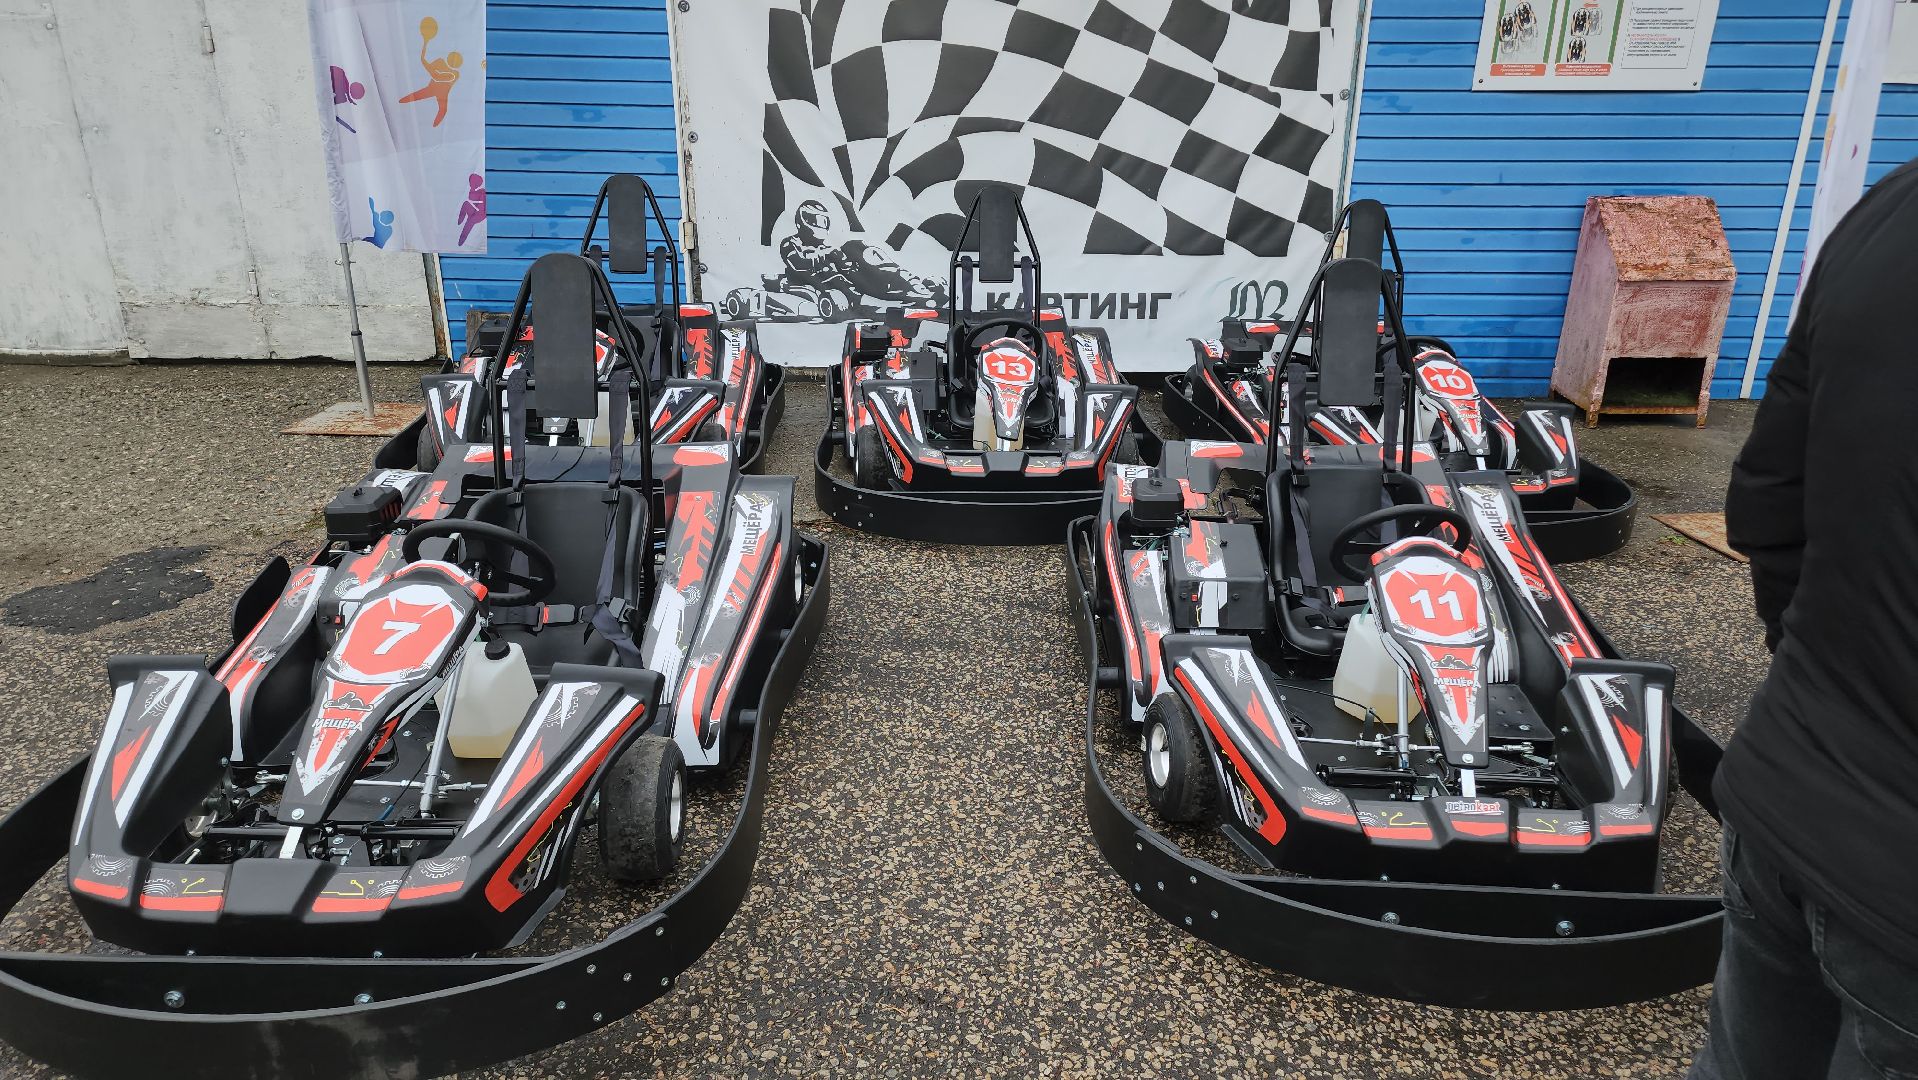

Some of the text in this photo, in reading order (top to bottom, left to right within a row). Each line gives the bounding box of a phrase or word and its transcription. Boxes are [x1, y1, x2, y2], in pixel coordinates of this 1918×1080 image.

[991, 360, 1027, 377] 13
[1429, 373, 1467, 390] 10
[740, 501, 765, 557] МЕЩЁРА
[1410, 587, 1464, 622] 11
[373, 619, 422, 656] 7
[1433, 675, 1483, 692] МЕЩЁРА
[311, 716, 365, 733] МЕЩЁРА
